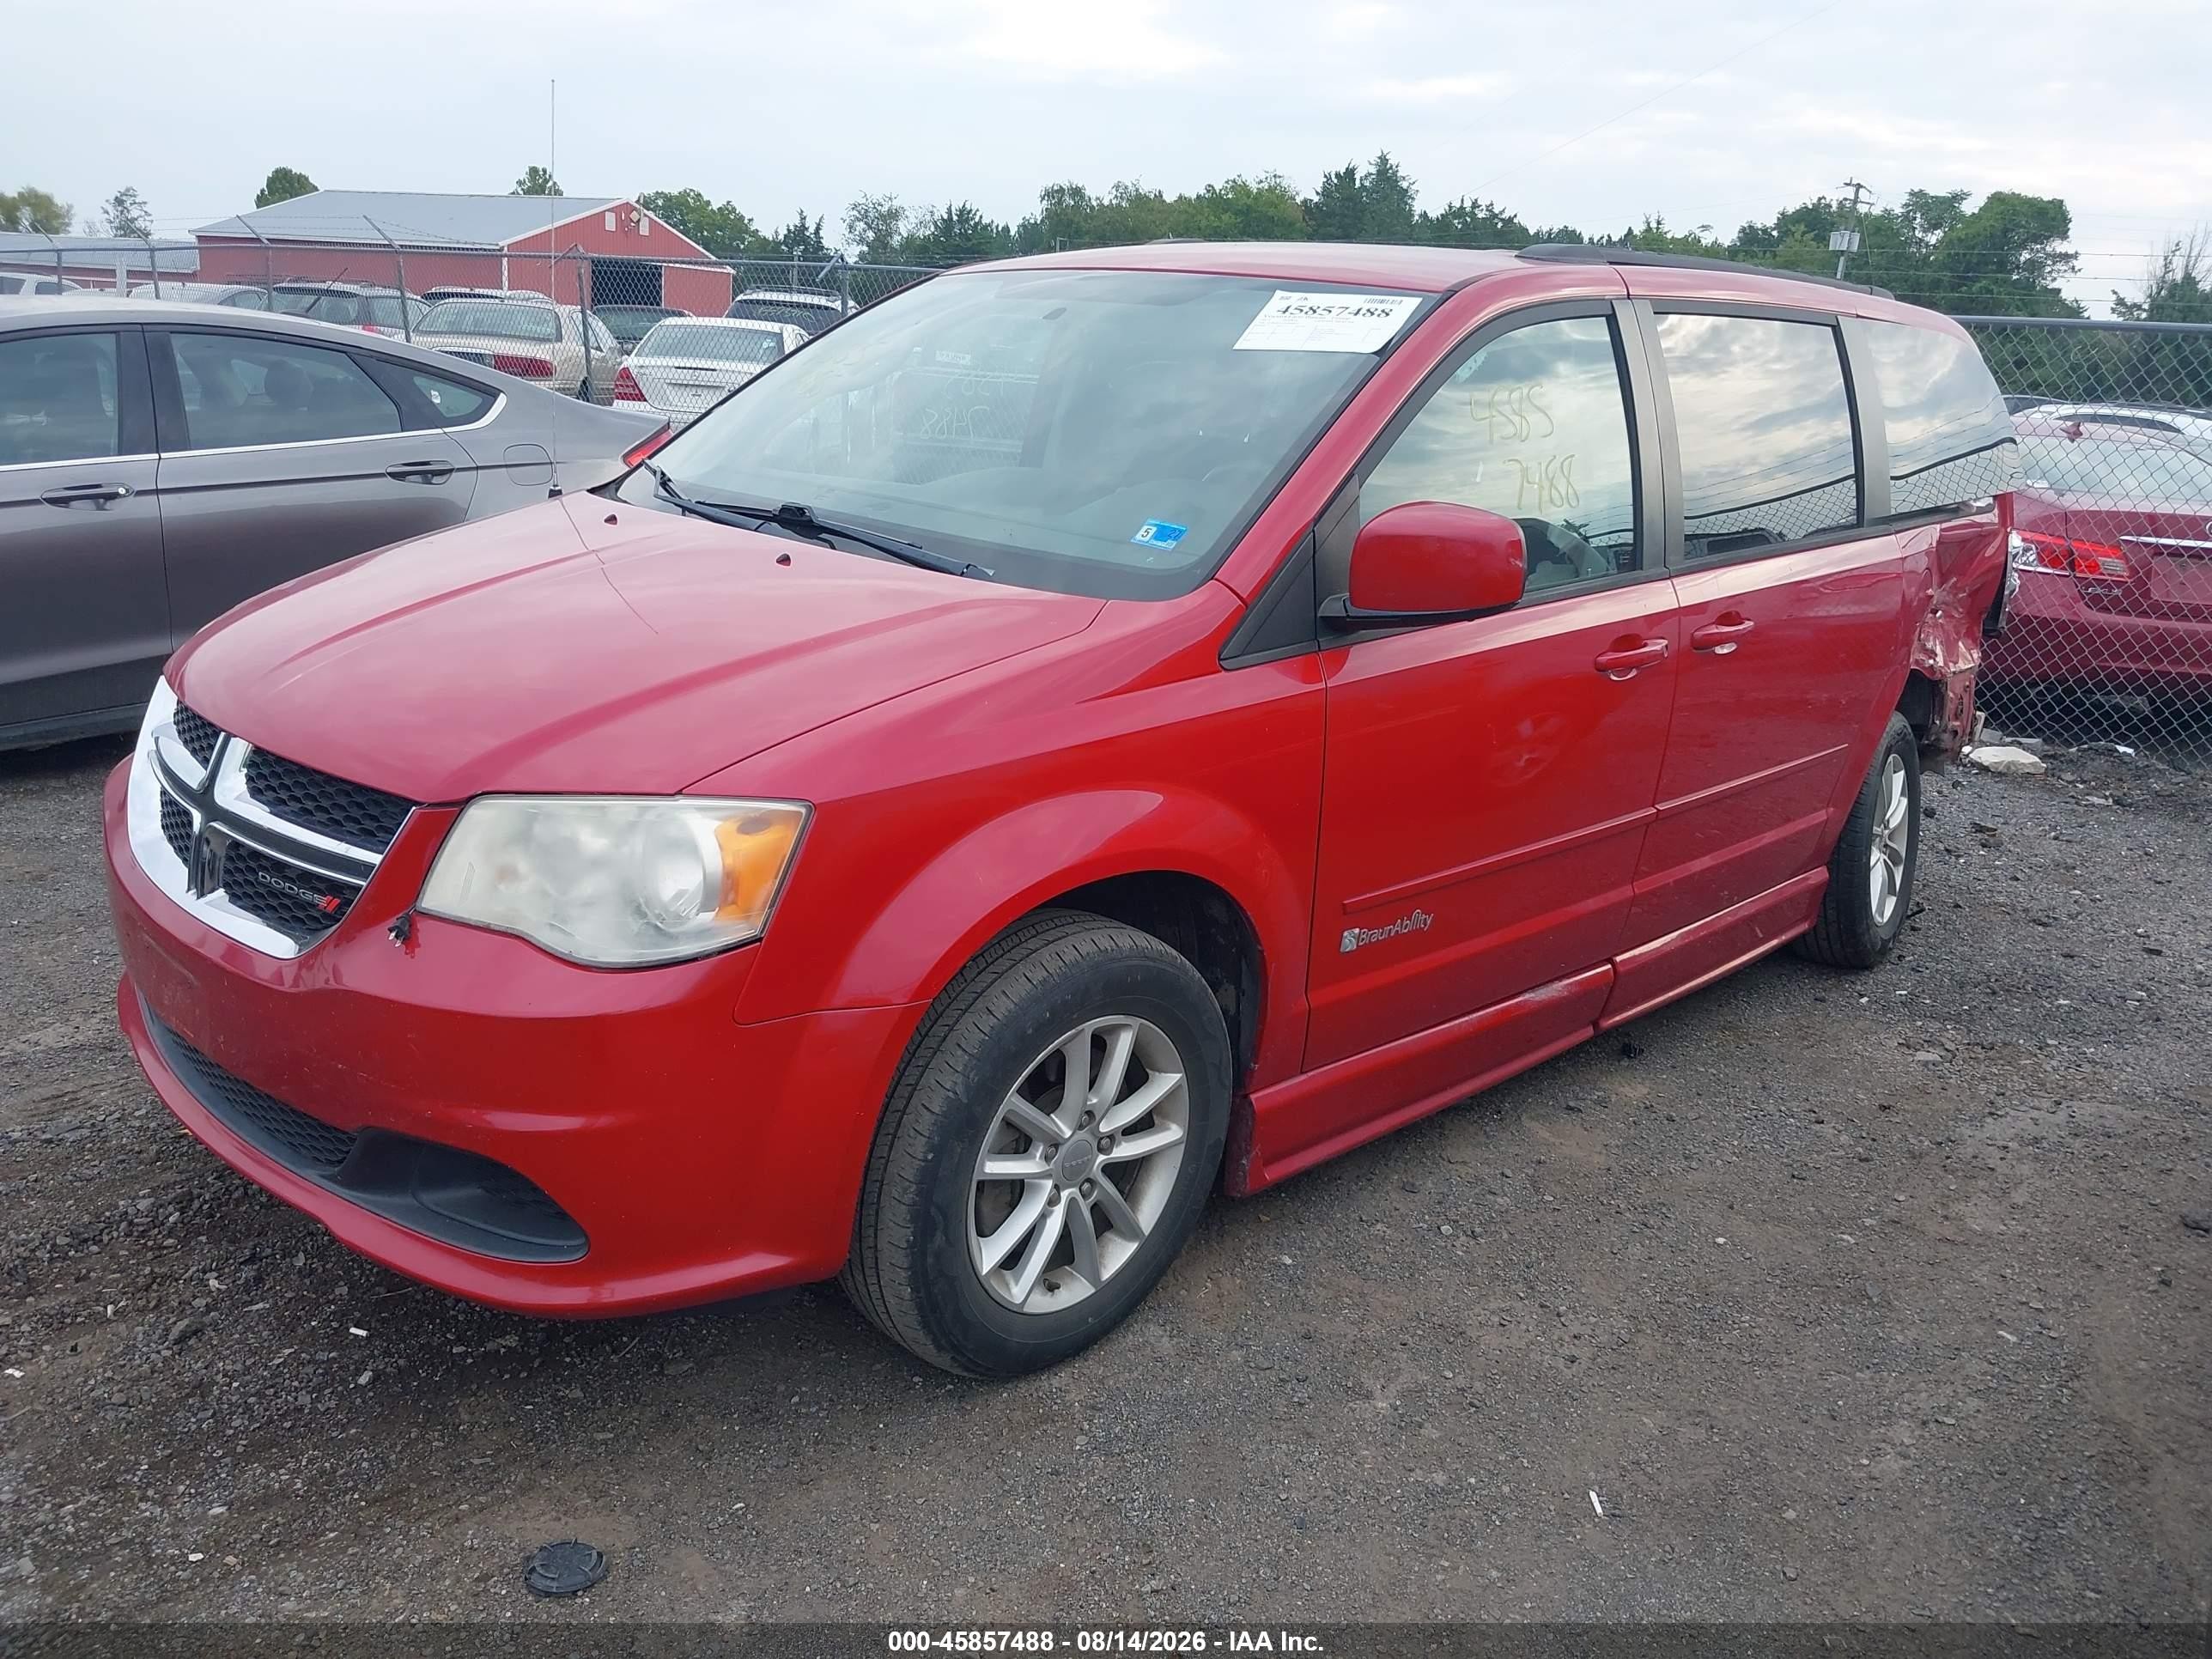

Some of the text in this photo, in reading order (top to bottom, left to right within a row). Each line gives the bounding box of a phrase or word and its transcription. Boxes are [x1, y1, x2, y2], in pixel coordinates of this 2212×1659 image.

[1276, 304, 1394, 319] 45857488
[1503, 453, 1580, 515] 7488
[1141, 527, 1152, 538] 5
[258, 871, 328, 908] DODGE
[1358, 908, 1434, 946] BraunAbility
